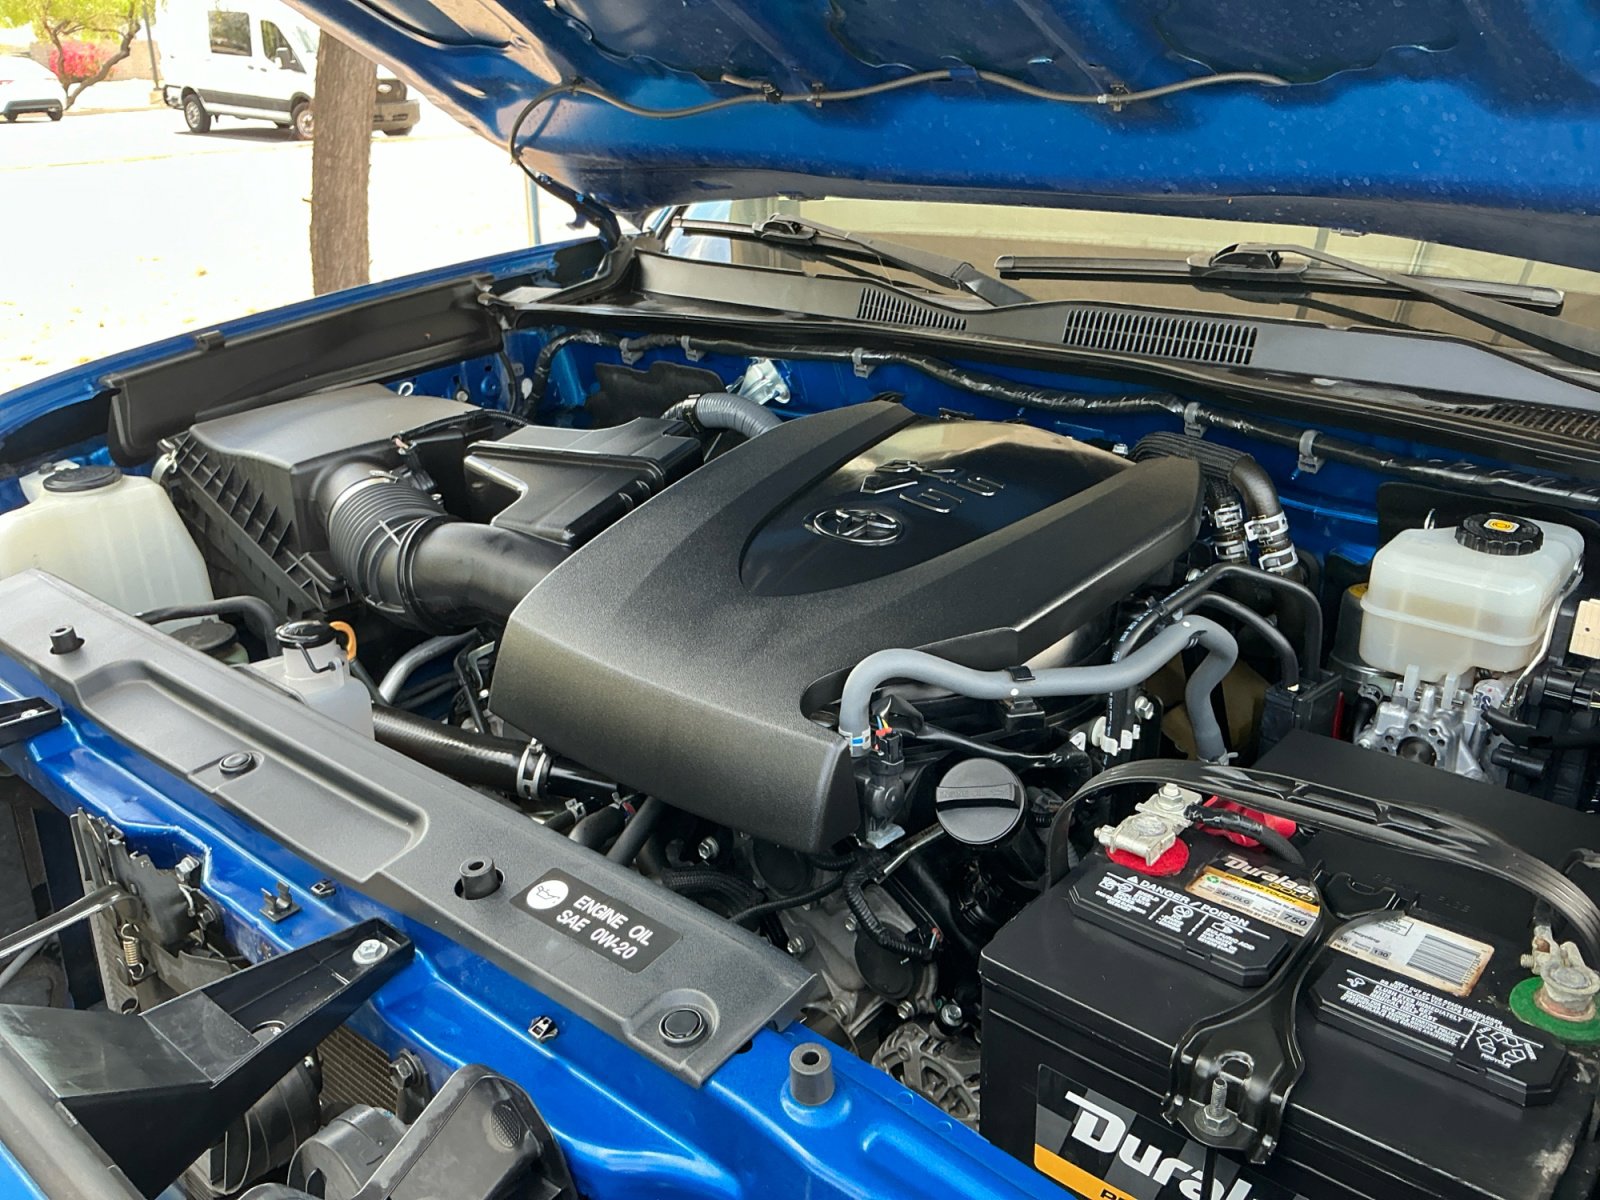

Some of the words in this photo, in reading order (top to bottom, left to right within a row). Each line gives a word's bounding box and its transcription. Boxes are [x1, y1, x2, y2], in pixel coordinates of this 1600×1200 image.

[1140, 880, 1190, 904] DANGER
[1200, 903, 1250, 928] POISON
[1270, 883, 1313, 902] GOLD
[556, 910, 591, 932] SAE
[590, 928, 638, 960] 0W-20
[573, 895, 629, 929] ENGINE
[628, 925, 654, 946] OIL
[1283, 914, 1308, 926] 750
